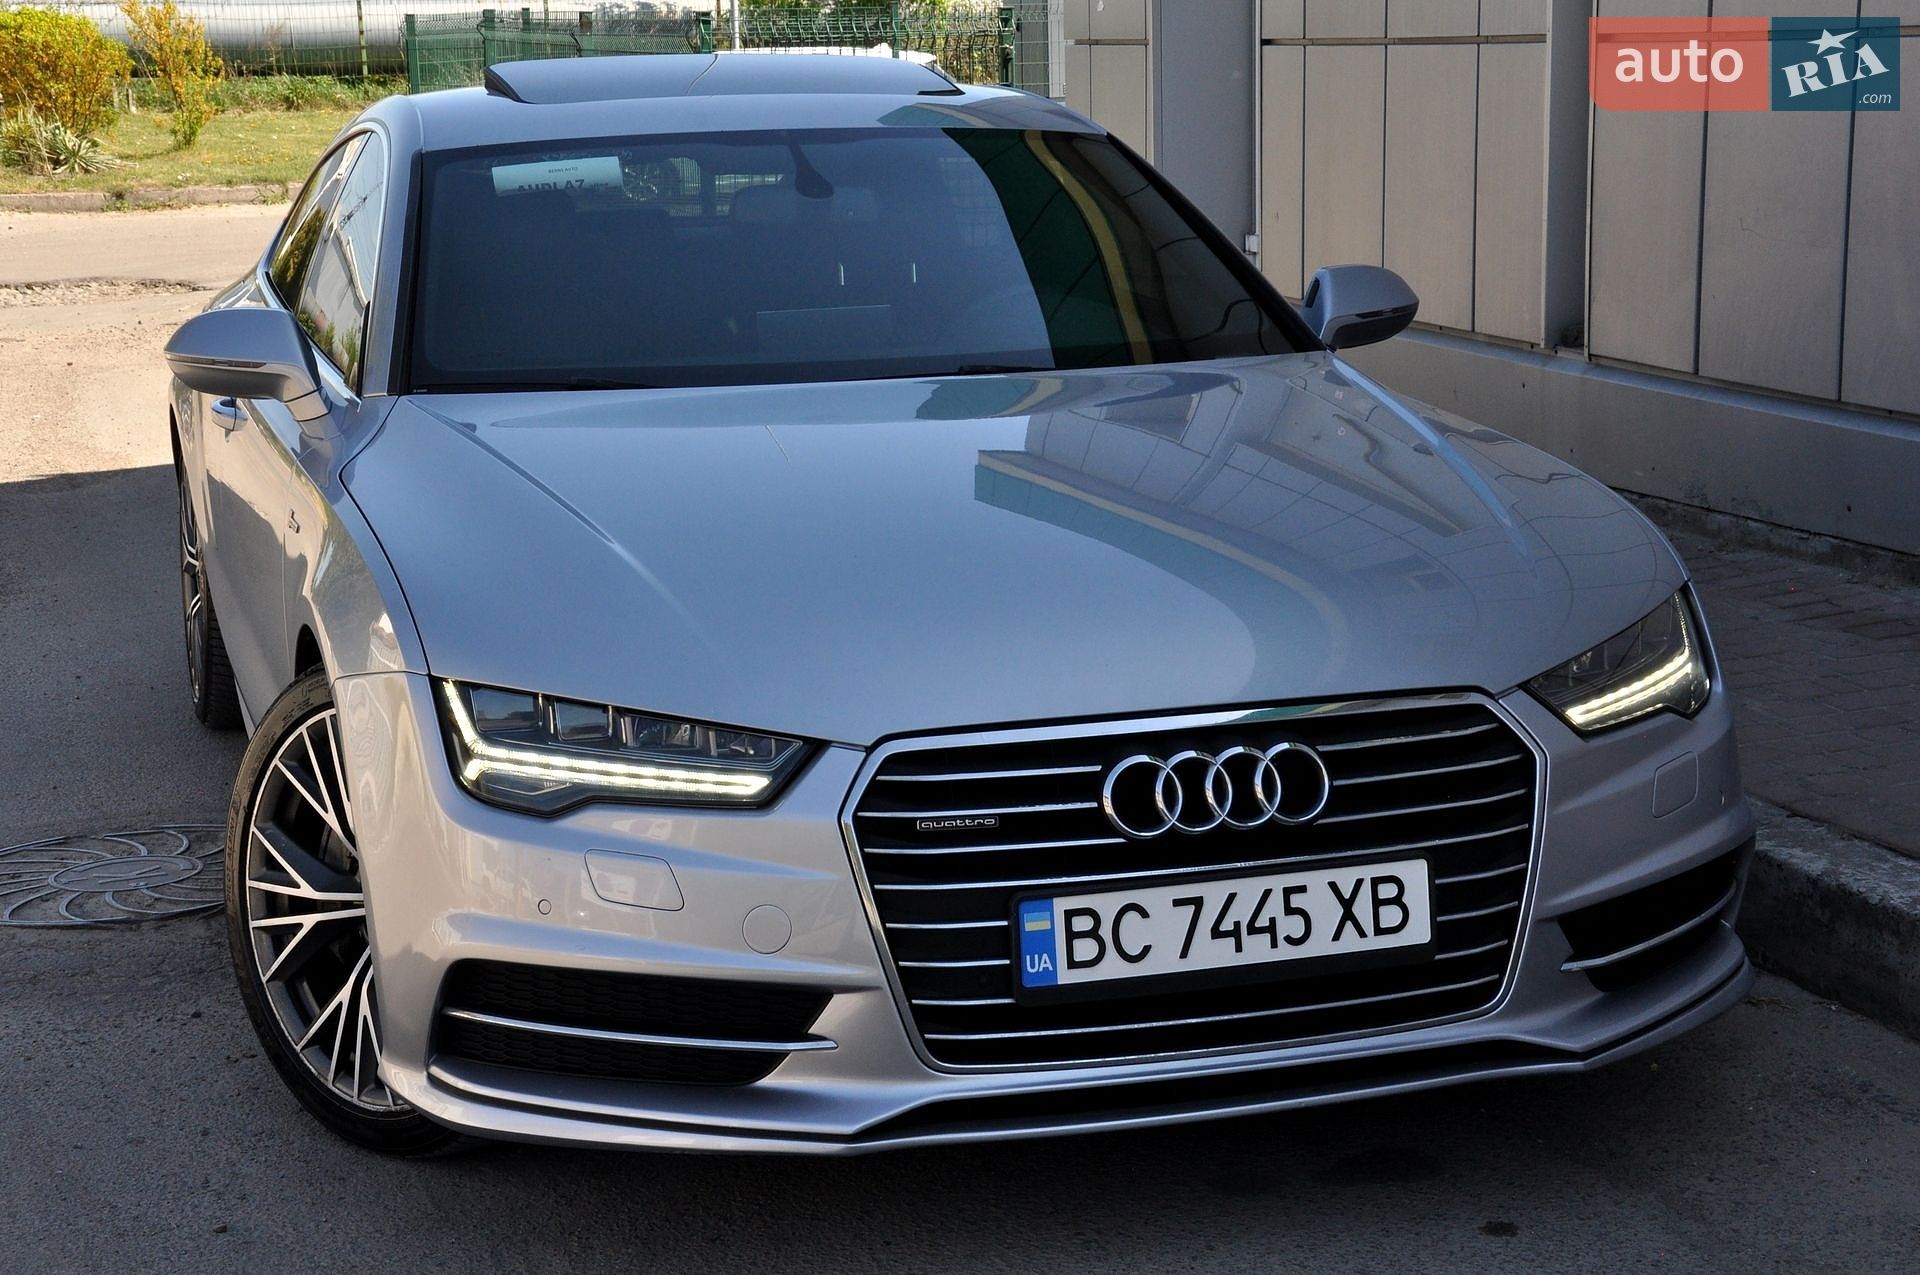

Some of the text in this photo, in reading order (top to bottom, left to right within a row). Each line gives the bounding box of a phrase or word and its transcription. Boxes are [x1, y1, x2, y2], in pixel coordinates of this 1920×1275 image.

[921, 818, 995, 829] quattro
[1063, 874, 1411, 971] BC 7445 XB
[1026, 953, 1053, 973] UA
